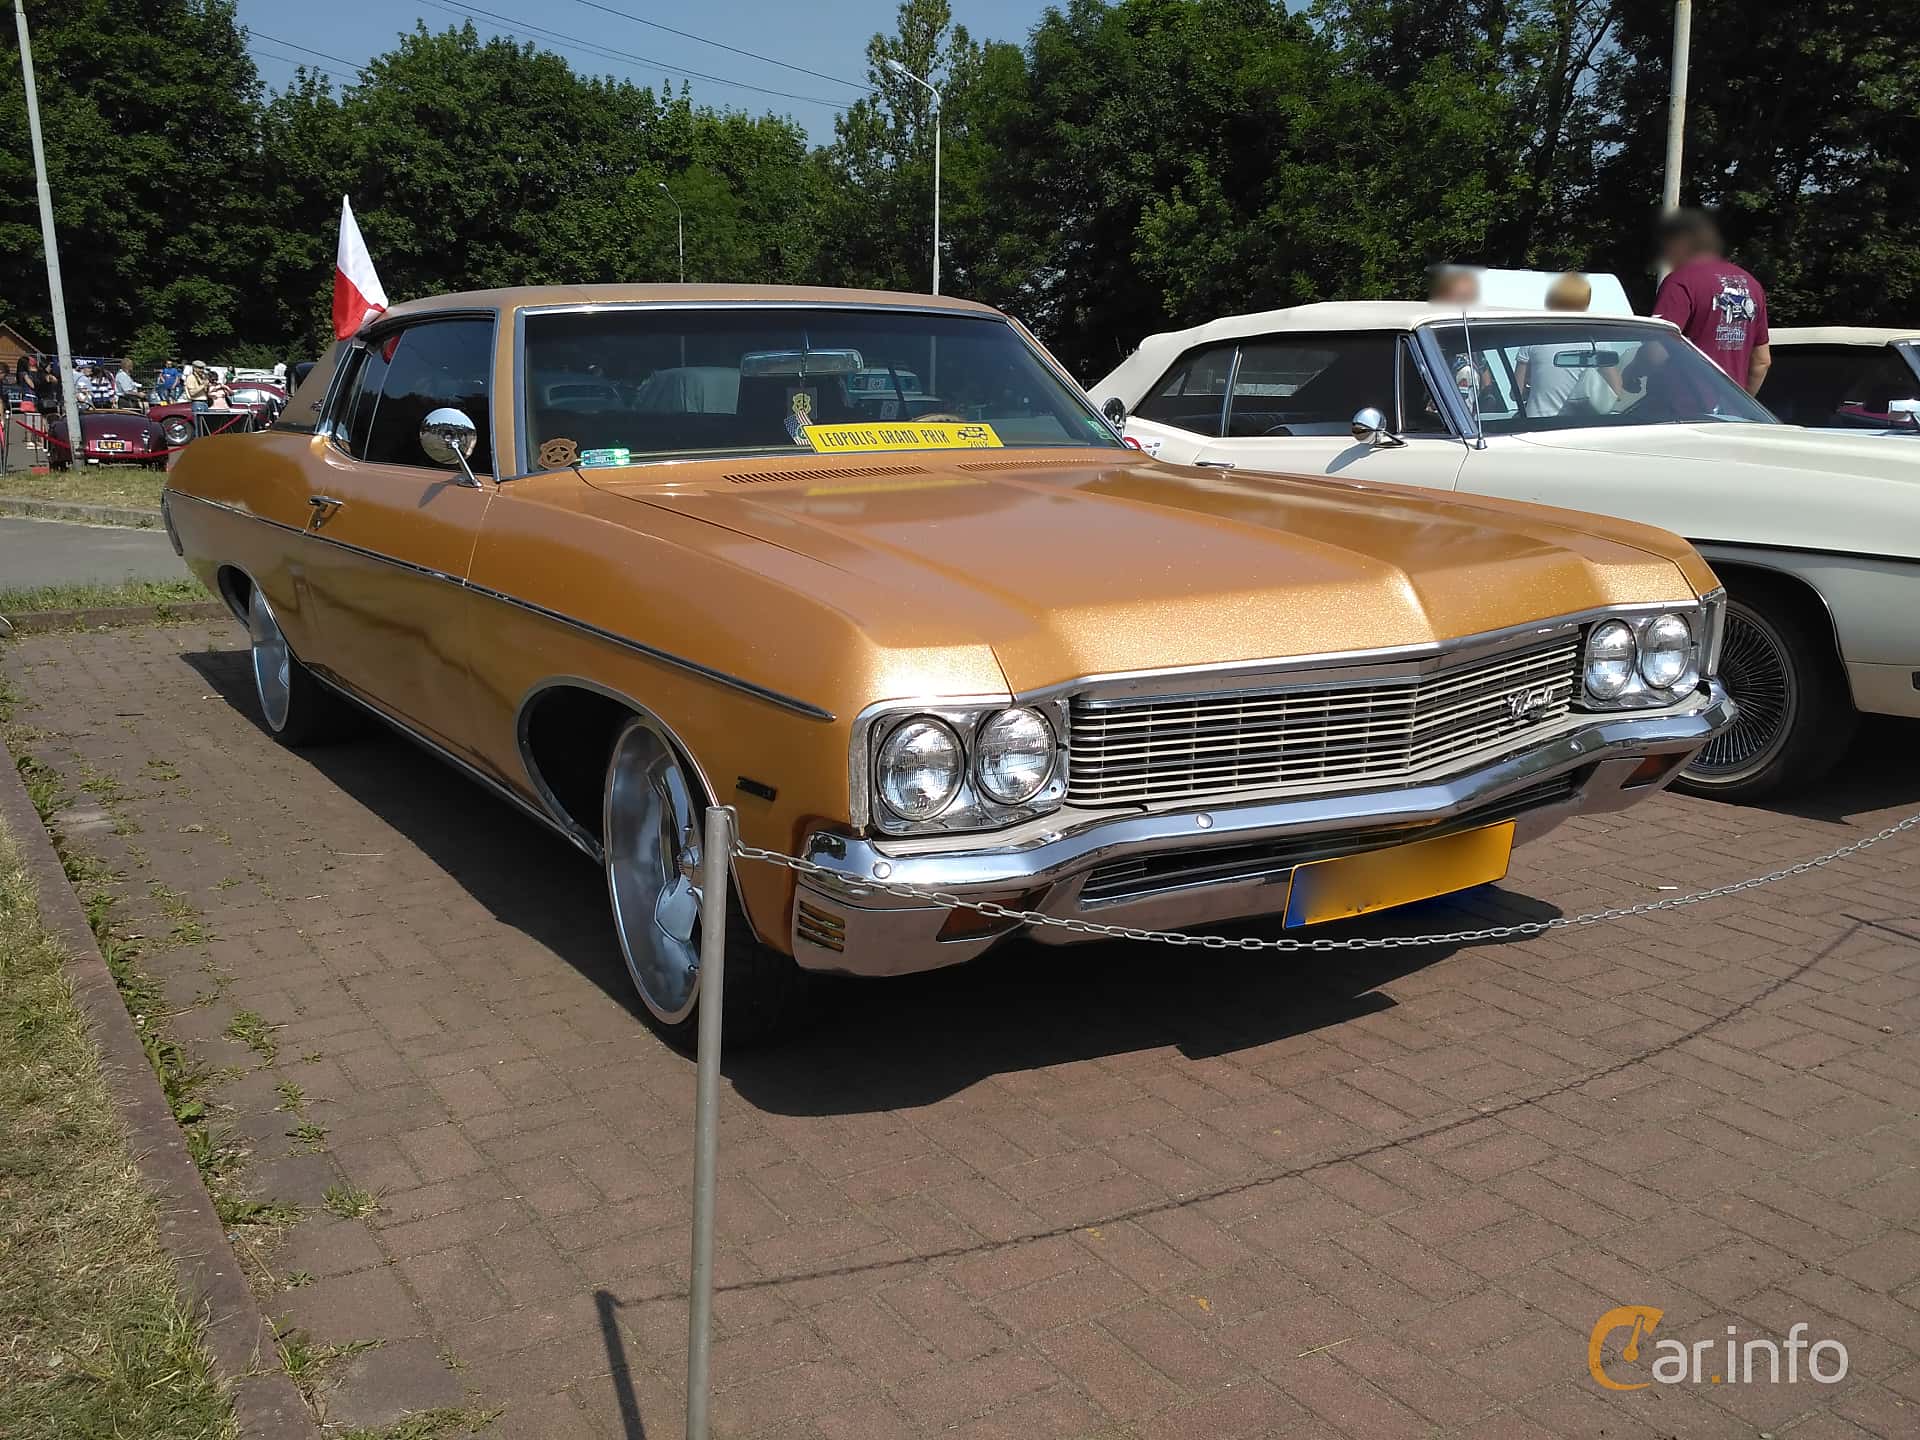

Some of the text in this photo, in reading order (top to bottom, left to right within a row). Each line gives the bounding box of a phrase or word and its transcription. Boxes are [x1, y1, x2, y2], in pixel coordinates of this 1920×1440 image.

[818, 429, 951, 447] LEOPOLIS GRAND PRIX
